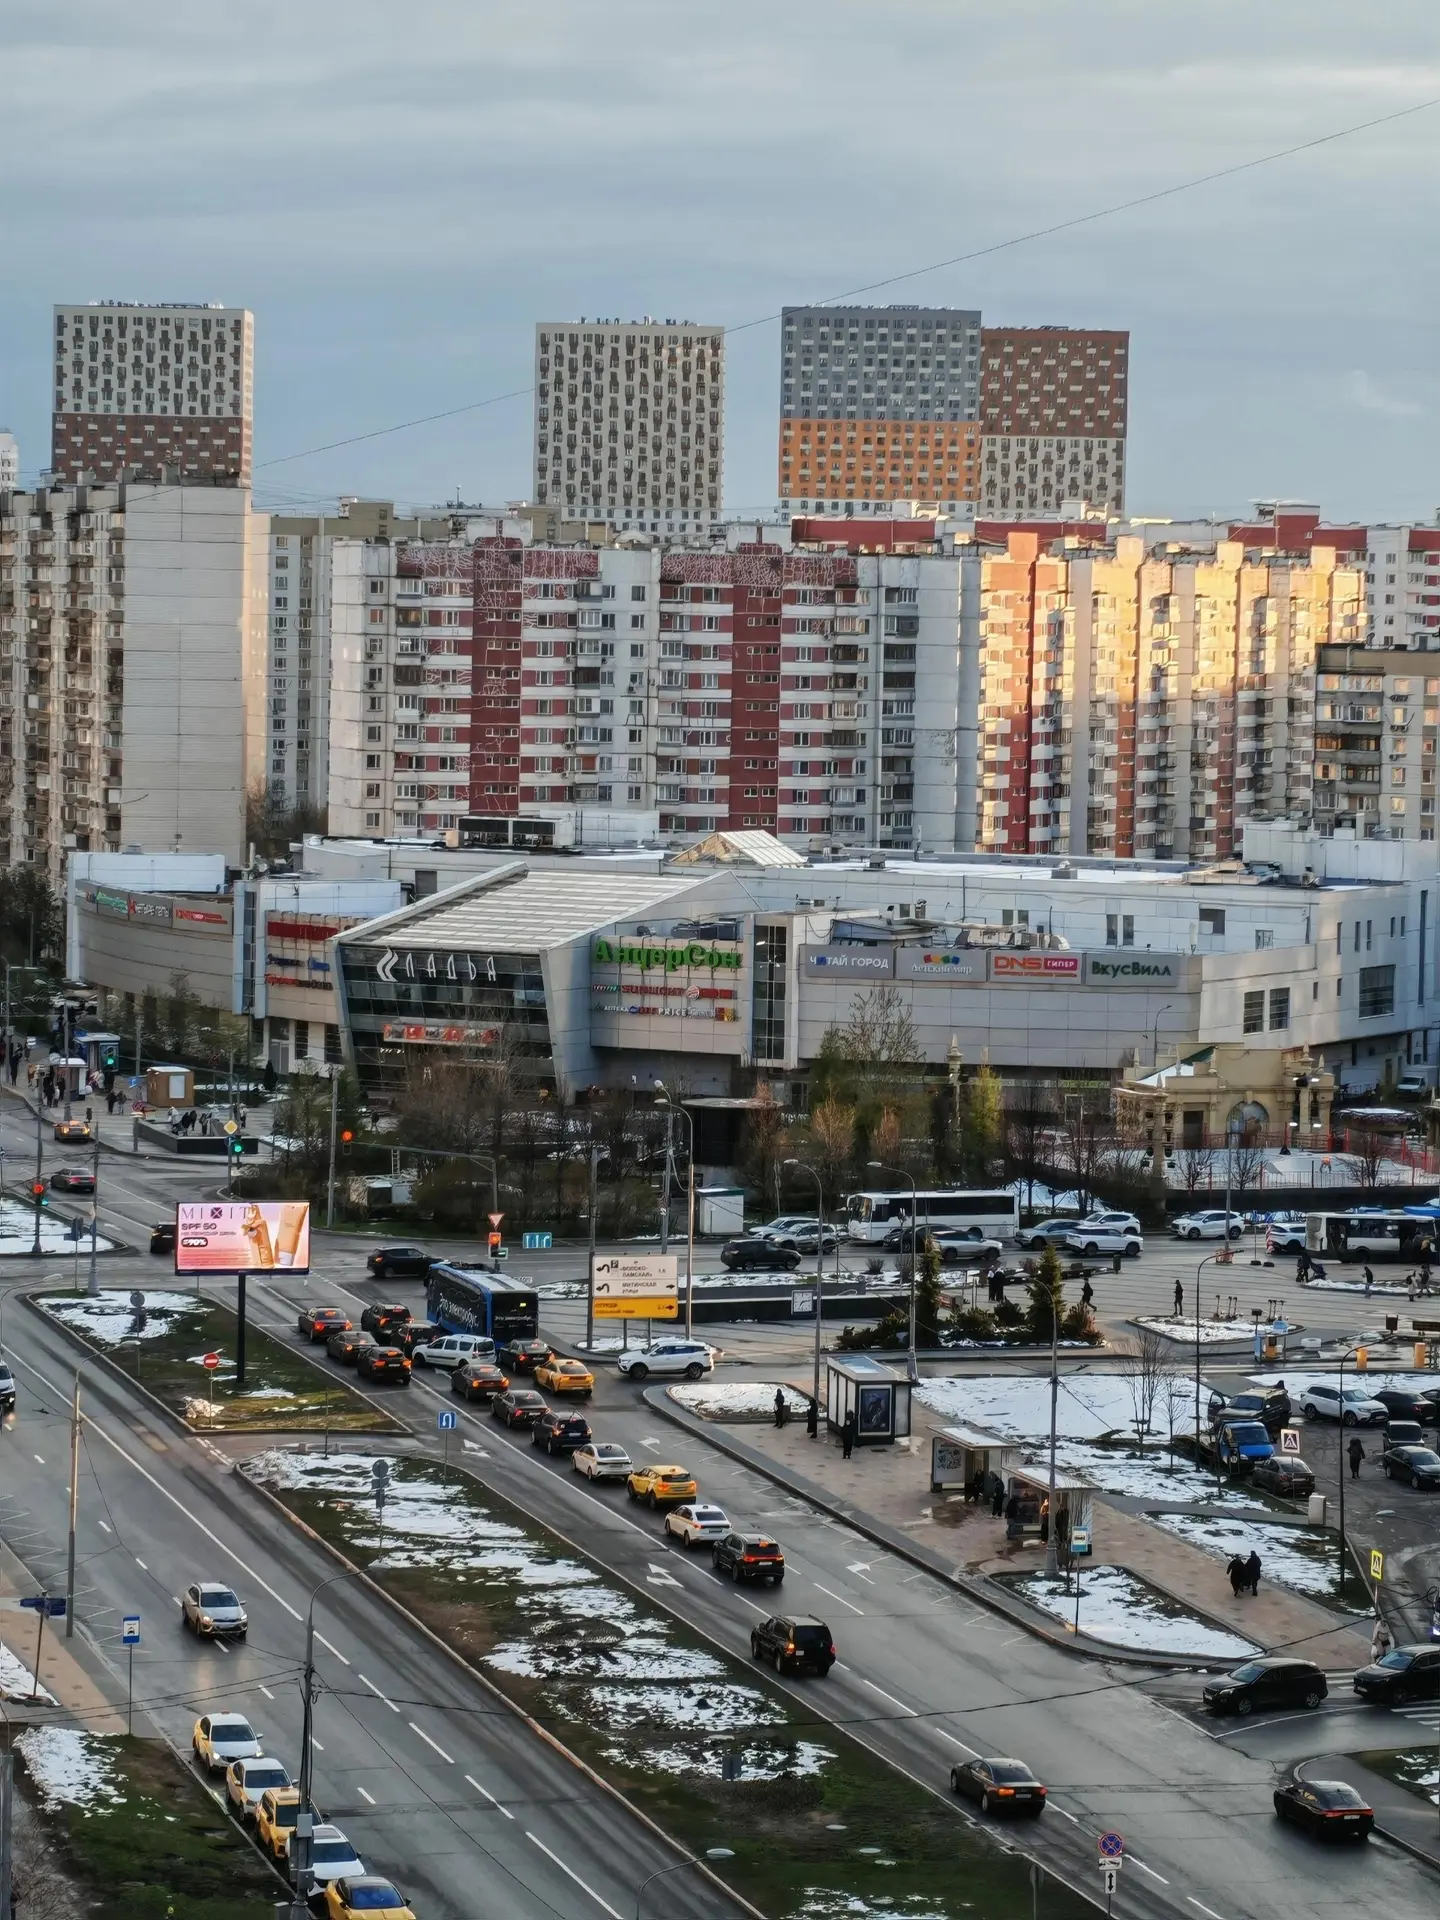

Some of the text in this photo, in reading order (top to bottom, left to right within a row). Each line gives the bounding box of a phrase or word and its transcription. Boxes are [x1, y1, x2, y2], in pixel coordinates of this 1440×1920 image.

[851, 956, 889, 969] ГОРОД
[994, 956, 1042, 970] DNS
[1047, 960, 1075, 968] ГИПЕР
[1091, 960, 1172, 978] ВкусВилл
[658, 1007, 689, 1017] PRICE
[181, 1222, 217, 1231] SPF 50
